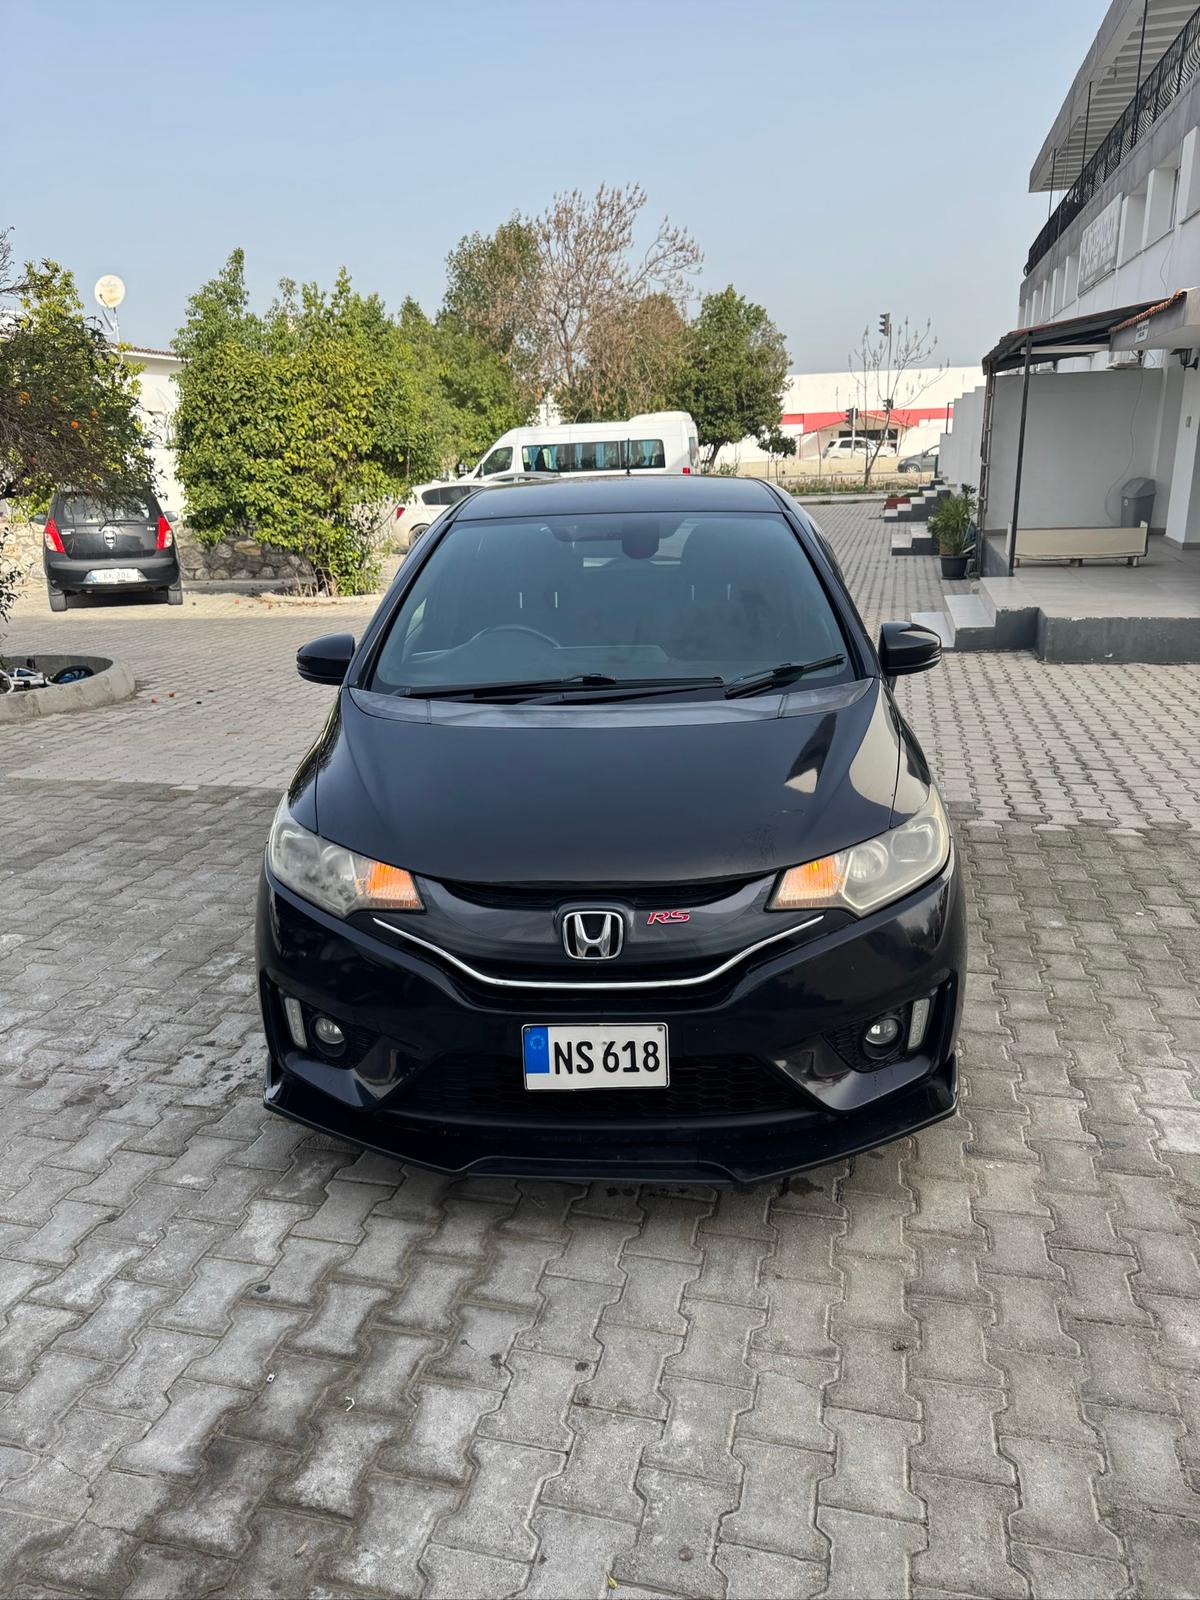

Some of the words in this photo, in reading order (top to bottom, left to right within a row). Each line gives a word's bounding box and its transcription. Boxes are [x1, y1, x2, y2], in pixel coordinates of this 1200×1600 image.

[647, 910, 691, 925] RS
[554, 1041, 595, 1074] NS
[602, 1041, 660, 1073] 618
